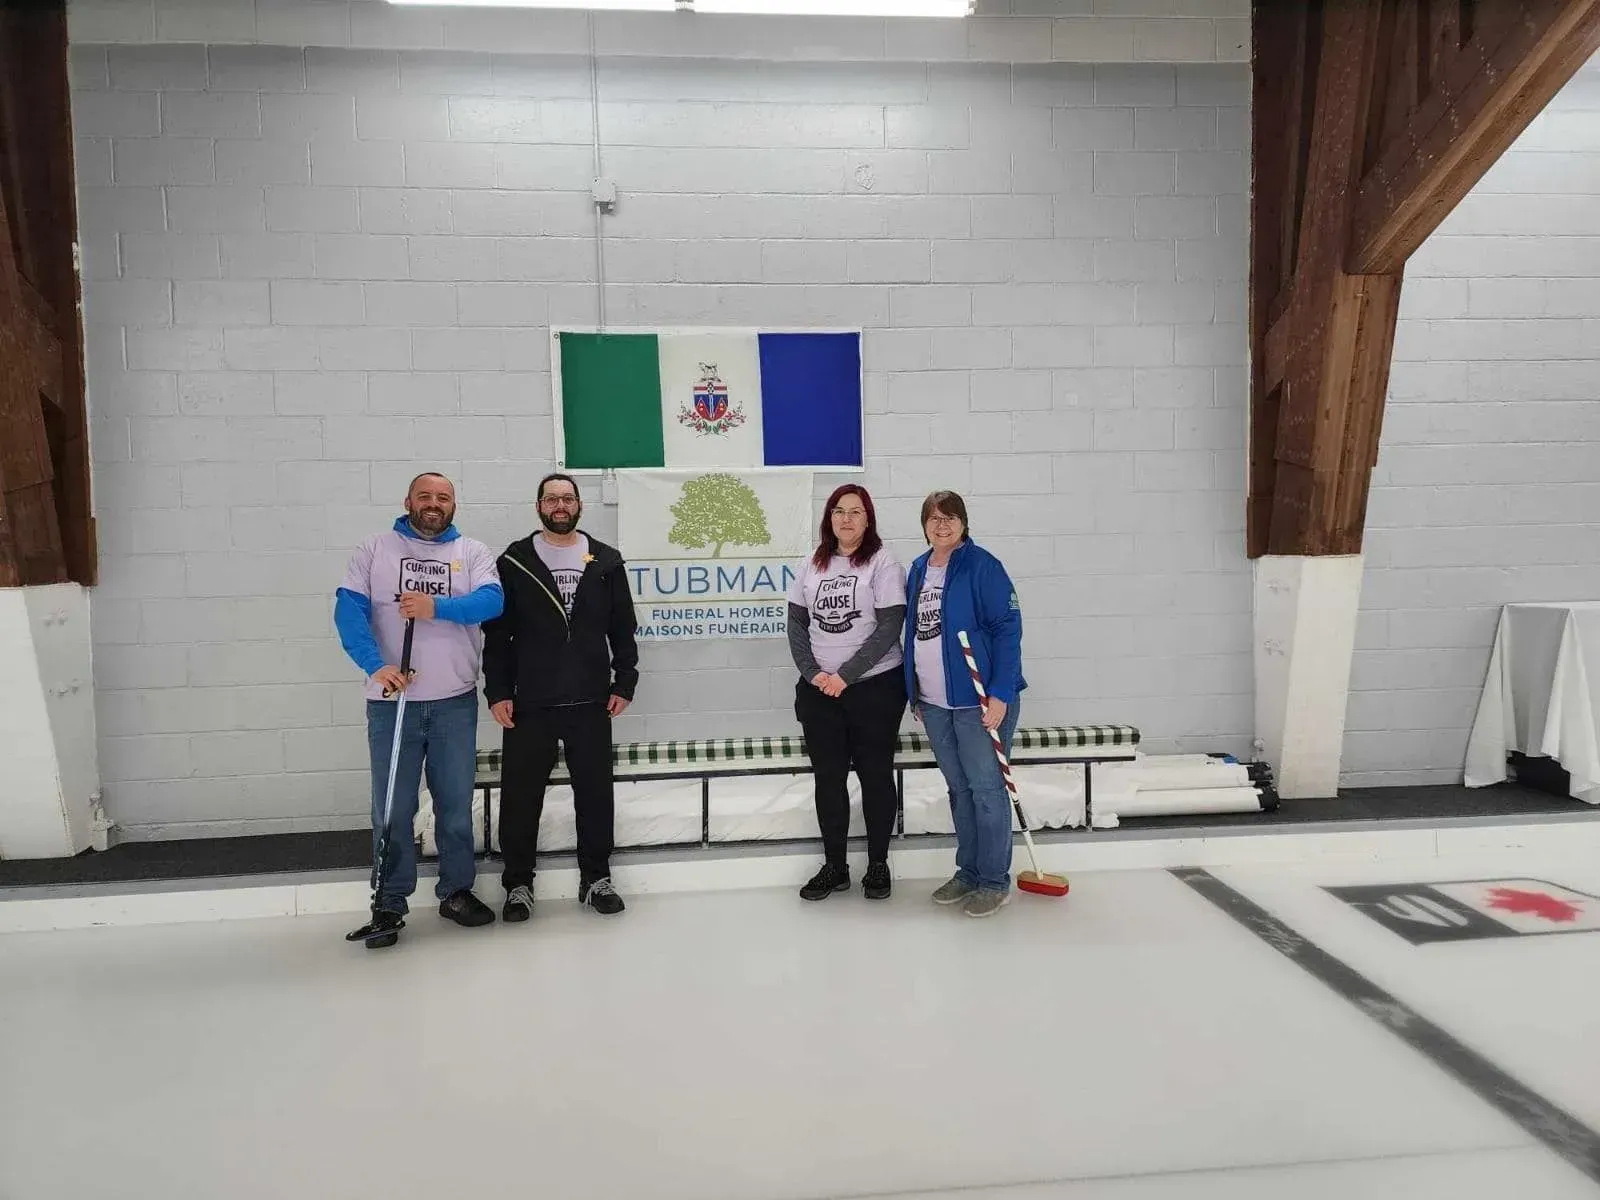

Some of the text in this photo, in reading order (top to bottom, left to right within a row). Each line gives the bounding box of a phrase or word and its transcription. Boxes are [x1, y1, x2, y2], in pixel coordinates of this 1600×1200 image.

[405, 562, 446, 576] CURLING
[405, 579, 446, 595] CAUSE
[628, 565, 796, 595] TUBMAN
[816, 594, 851, 610] CAUSE
[652, 606, 784, 620] FUNERAL HOMES
[635, 621, 786, 637] MAISONS FUNÉRAIR
